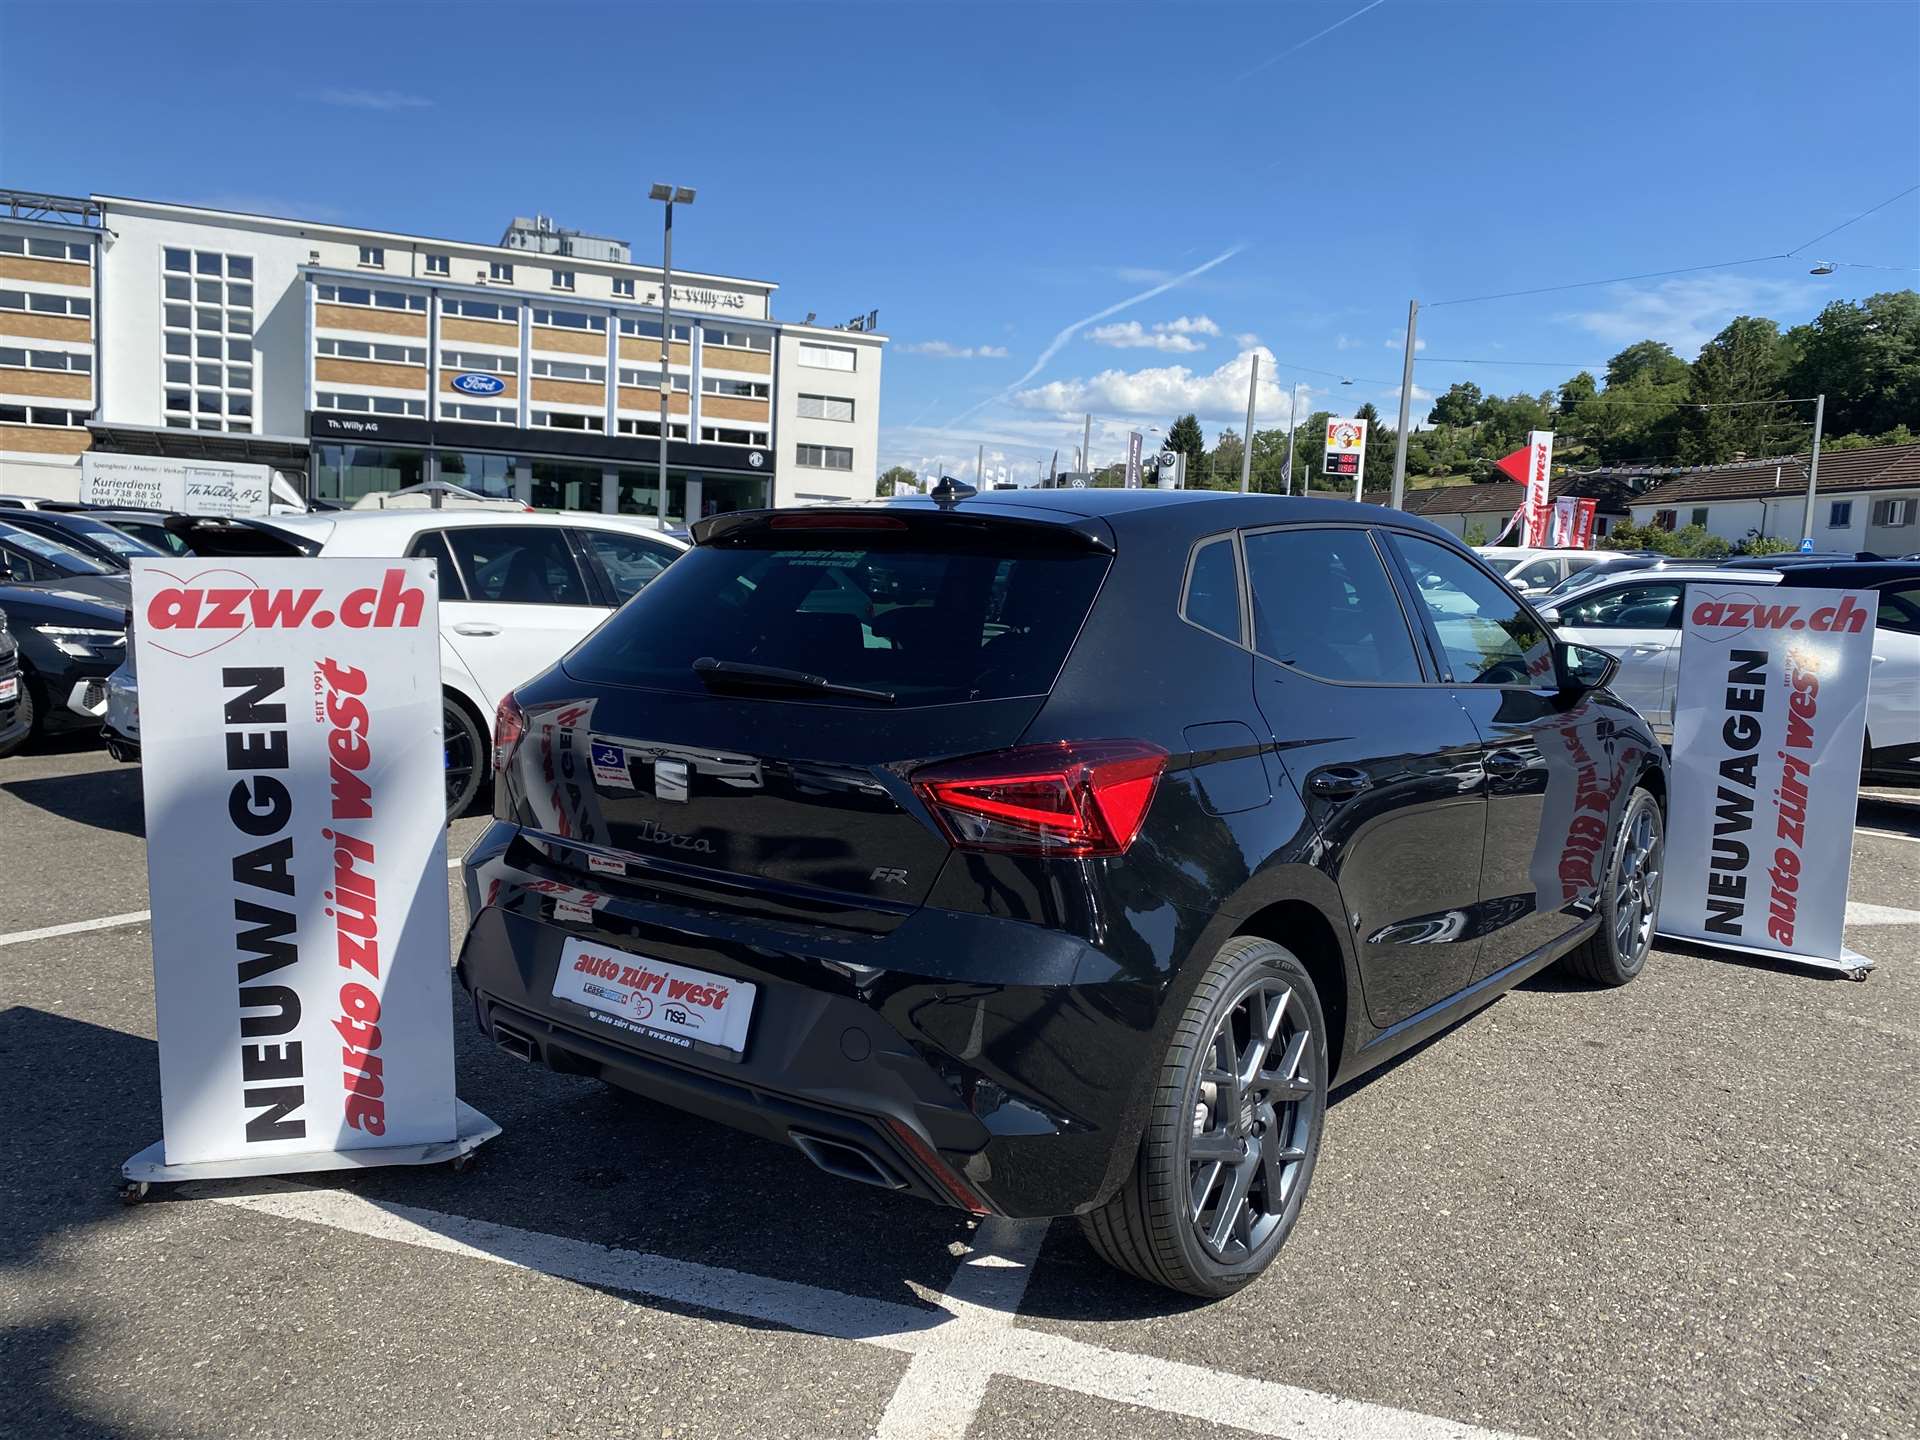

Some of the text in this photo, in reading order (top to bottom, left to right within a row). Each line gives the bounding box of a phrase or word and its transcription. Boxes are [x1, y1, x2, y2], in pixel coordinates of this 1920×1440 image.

[685, 288, 717, 309] Willy
[722, 294, 745, 309] AG
[463, 375, 497, 392] Ford
[328, 419, 378, 432] Th. Willy AG
[1535, 443, 1548, 481] west
[91, 487, 162, 500] 044 738 88 50
[93, 476, 161, 491] Kurierdienst
[202, 485, 239, 502] Willy
[240, 489, 264, 504] AG
[91, 497, 162, 509] www.thwilly.ch
[147, 569, 425, 630] azw.ch
[1692, 596, 1868, 633] azw.ch
[314, 670, 325, 724] SEIT 1991
[1704, 649, 1769, 937] NEUWAGEN
[1773, 751, 1813, 849] züri
[638, 819, 717, 854] Ibiza
[869, 866, 911, 889] FR
[222, 666, 307, 1143] NEUWAGEN
[314, 657, 386, 1137] auto züri west
[1767, 847, 1802, 948] auto
[574, 952, 729, 1010] auto züri west
[597, 1014, 691, 1048] auto züri west www.azw.ch
[664, 1008, 686, 1025] nsa
